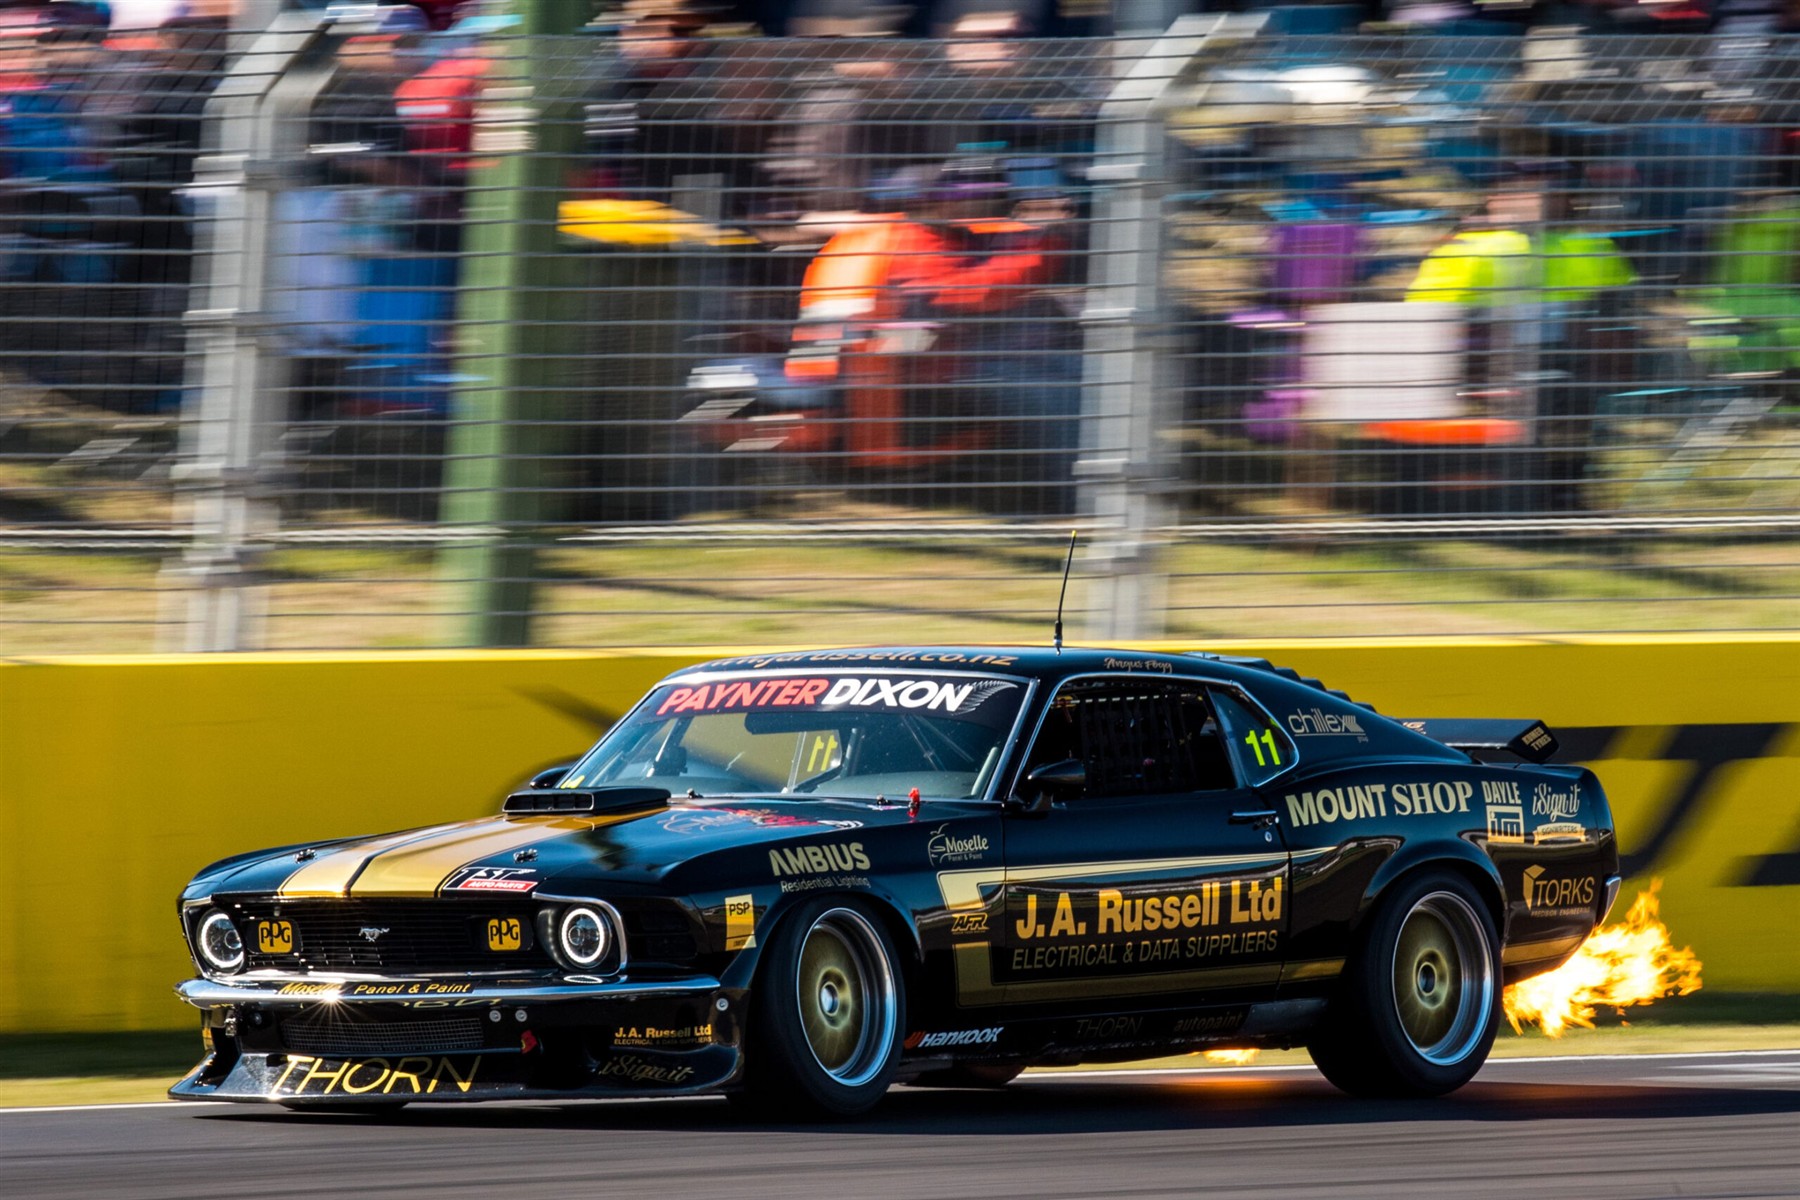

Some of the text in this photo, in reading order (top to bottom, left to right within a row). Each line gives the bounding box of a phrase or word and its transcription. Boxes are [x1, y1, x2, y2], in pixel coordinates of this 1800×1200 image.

[656, 678, 974, 715] PAYNTER DIXON
[1245, 729, 1281, 766] 11
[1285, 781, 1473, 827] MOUNT SHOP
[1481, 781, 1522, 805] DAYLE
[945, 835, 989, 853] Moselle
[769, 842, 871, 876] AMBIUS
[781, 875, 871, 893] Residential Lighting
[1536, 876, 1595, 907] TORKS
[729, 902, 750, 916] PSP
[1098, 882, 1221, 934] Russell
[1231, 877, 1283, 924] Ltd
[260, 920, 290, 947] PPG
[490, 918, 519, 945] PPG
[1012, 930, 1278, 970] ELECTRICAL & DATA SUPPLIERS
[354, 984, 402, 994] Panel
[408, 984, 420, 994] &
[425, 983, 471, 993] Paint
[645, 1026, 691, 1039] Russell
[694, 1023, 712, 1036] Ltd
[269, 1055, 481, 1099] THORN
